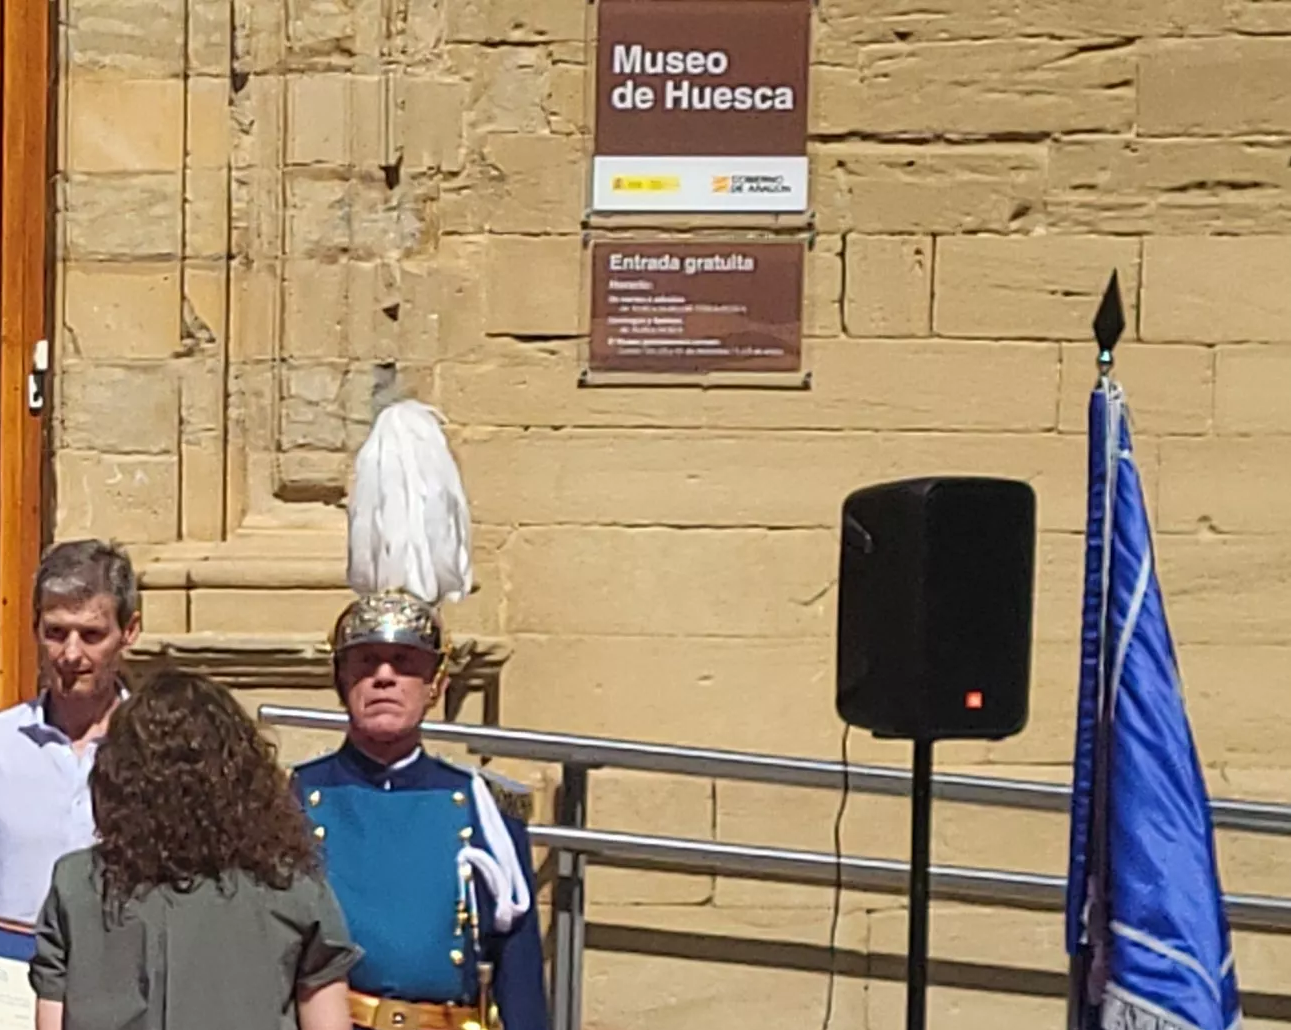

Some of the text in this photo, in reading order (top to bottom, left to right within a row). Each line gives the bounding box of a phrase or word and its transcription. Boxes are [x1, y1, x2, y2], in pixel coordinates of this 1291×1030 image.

[612, 44, 729, 75] Museo
[611, 79, 795, 110] de Huesca
[608, 253, 755, 274] Entrada gratuita
